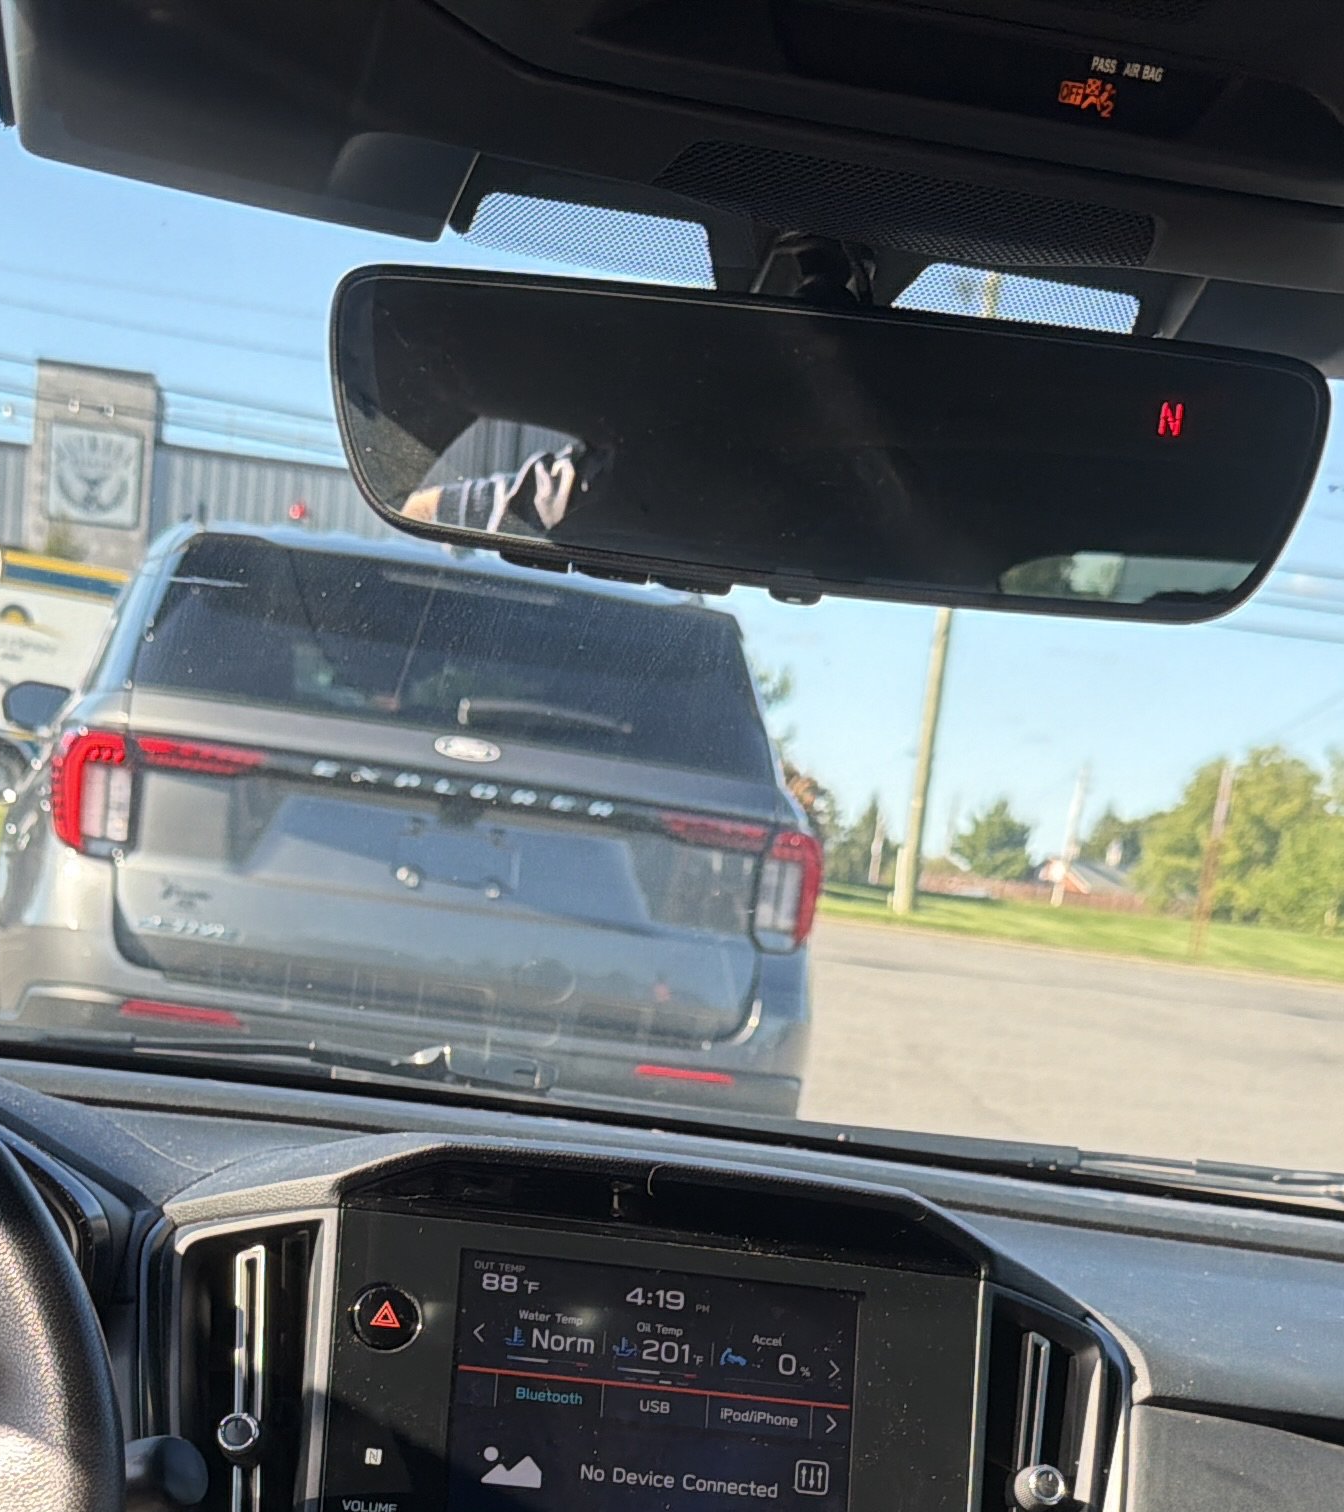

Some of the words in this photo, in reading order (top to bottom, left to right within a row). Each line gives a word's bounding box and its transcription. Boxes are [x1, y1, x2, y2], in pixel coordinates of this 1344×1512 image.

[1091, 56, 1118, 74] PASS
[1123, 62, 1141, 78] AIR
[1142, 65, 1164, 82] BAG
[1059, 82, 1084, 105] OFF
[1157, 401, 1184, 437] N
[474, 1260, 495, 1271] OUT
[499, 1262, 526, 1273] TEMP
[481, 1272, 518, 1294] 88
[625, 1286, 685, 1311] 4:19
[695, 1303, 710, 1314] PM
[519, 1309, 550, 1323] Water
[555, 1313, 583, 1328] Temp
[637, 1321, 652, 1335] Oil
[655, 1324, 684, 1338] Temp
[532, 1328, 595, 1355] Norm
[752, 1333, 782, 1348] Accel
[642, 1338, 691, 1366] 201
[778, 1352, 797, 1377] 0
[516, 1386, 584, 1406] Bluetooth
[639, 1399, 670, 1415] USB
[720, 1407, 798, 1428] iPod/iPhone
[580, 1463, 605, 1483] No
[612, 1467, 675, 1490] Device
[682, 1474, 778, 1500] Connected
